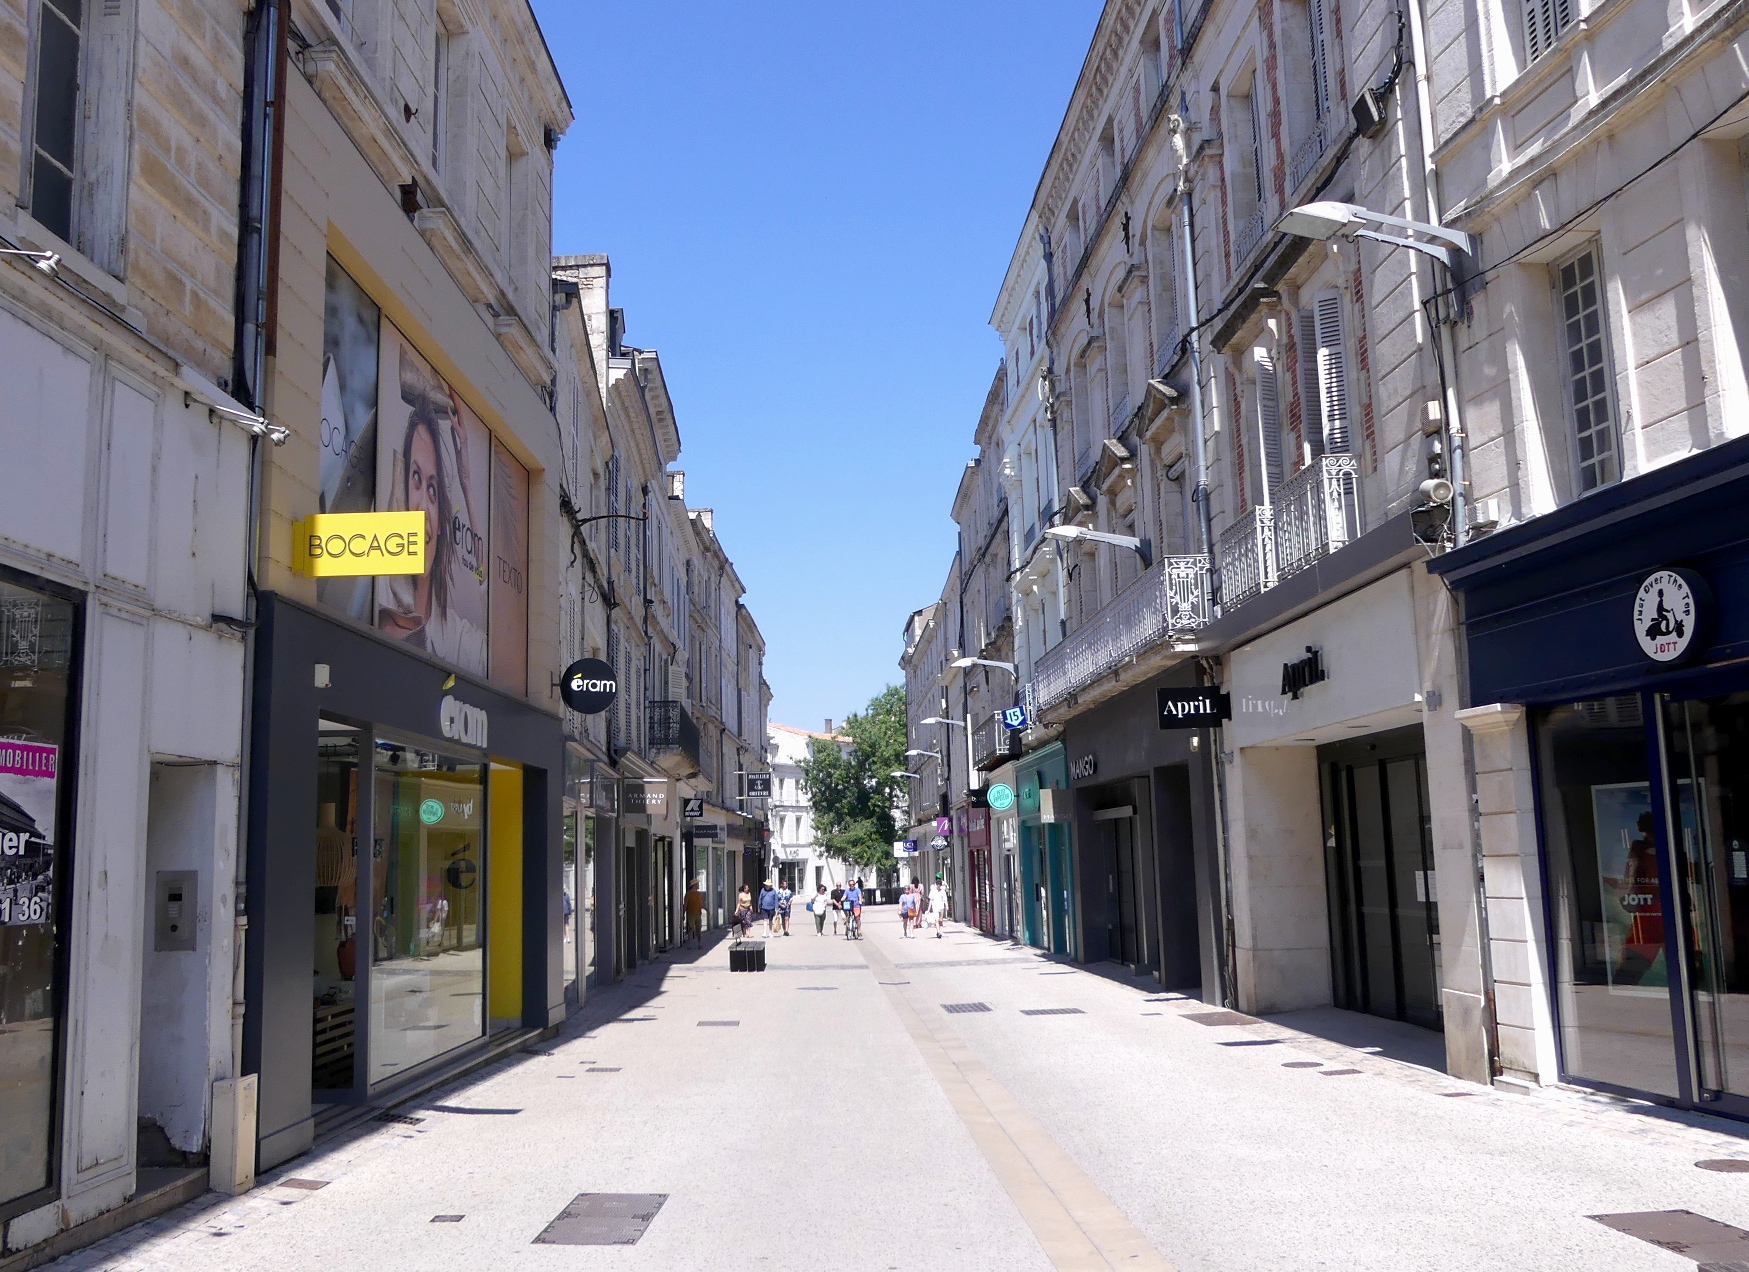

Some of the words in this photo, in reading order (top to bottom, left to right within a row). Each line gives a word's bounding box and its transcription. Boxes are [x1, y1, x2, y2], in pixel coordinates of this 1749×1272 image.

[308, 532, 419, 559] BOCAGE
[497, 555, 523, 594] TEXTO
[1636, 597, 1646, 624] Just
[1643, 575, 1663, 595] Over
[1667, 574, 1683, 591] The
[1682, 591, 1691, 616] Top
[1654, 641, 1678, 654] JOTT
[570, 672, 616, 693] éram
[440, 674, 488, 748] éram
[1070, 754, 1094, 781] MANGO
[18, 896, 42, 921] 36
[1622, 894, 1653, 906] JOTT
